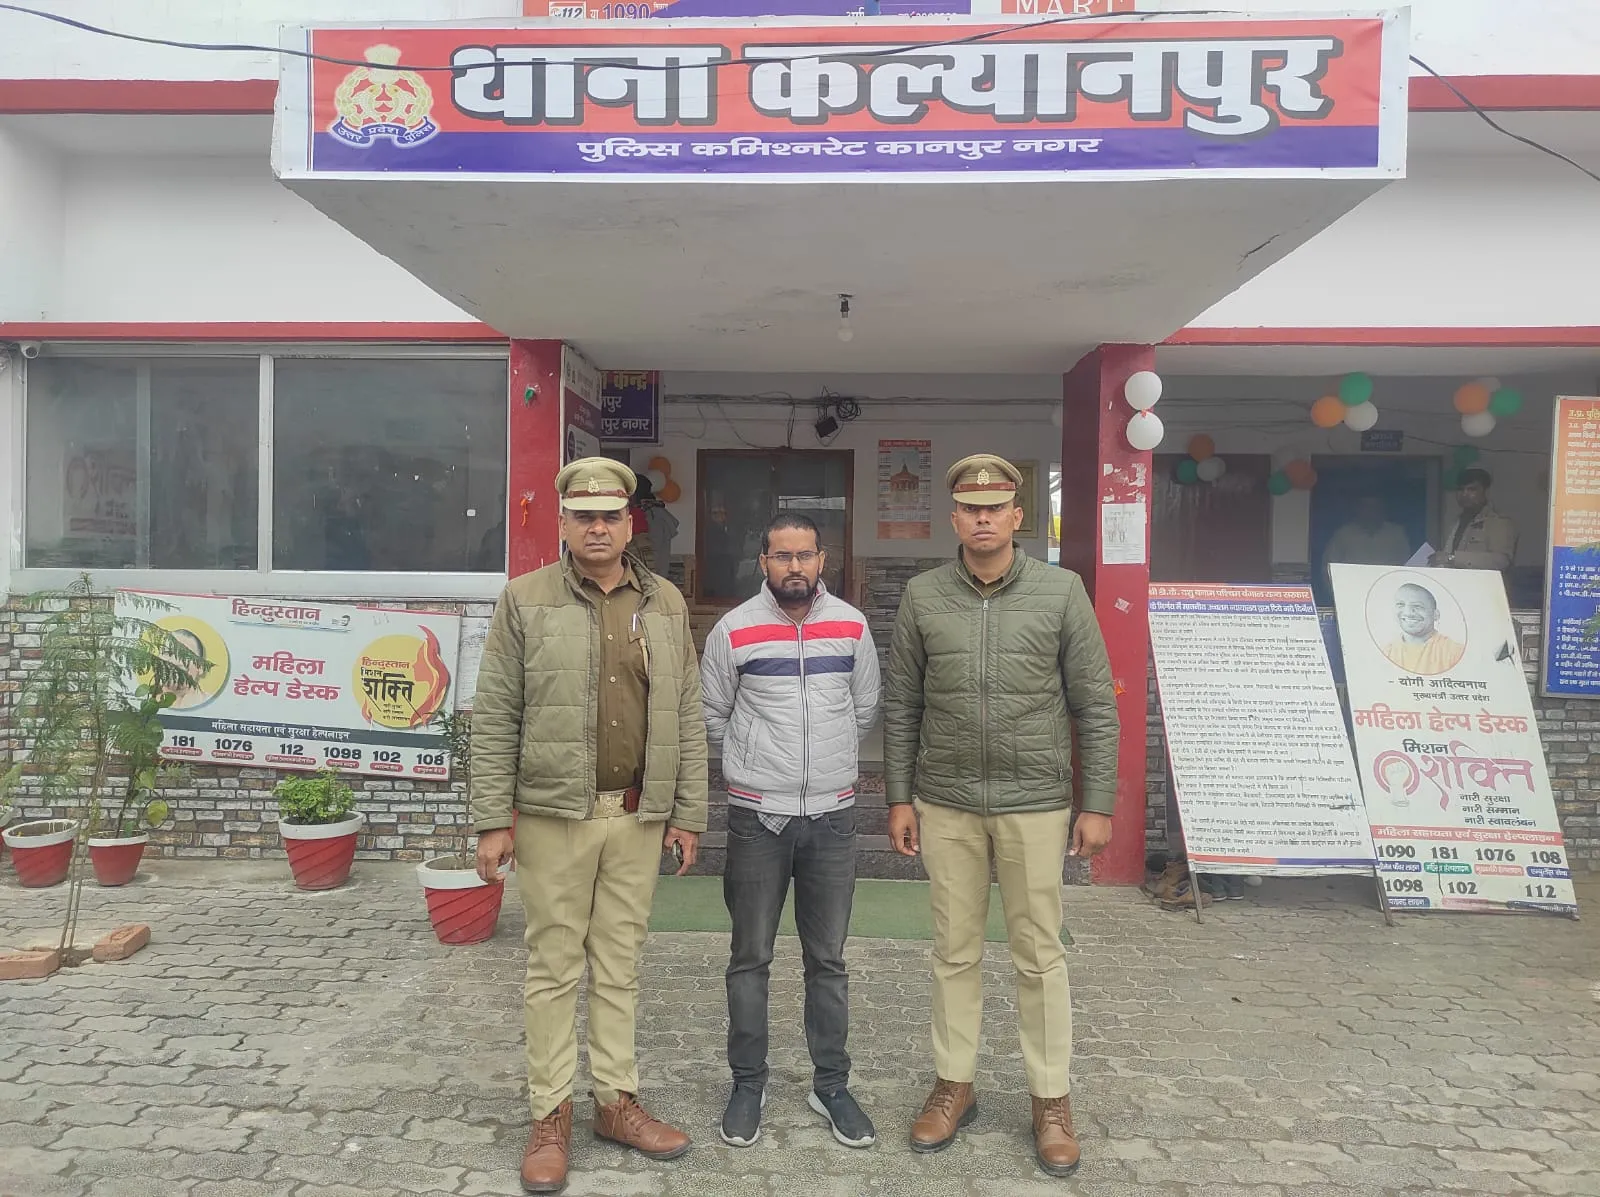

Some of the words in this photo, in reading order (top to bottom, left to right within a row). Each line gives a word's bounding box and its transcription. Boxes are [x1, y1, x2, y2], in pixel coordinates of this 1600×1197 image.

[602, 3, 651, 19] 1090
[1016, 0, 1123, 15] MART
[452, 43, 730, 127] थाना
[740, 36, 1343, 139] कल्यानपुर
[338, 127, 362, 142] उत्तर
[368, 125, 399, 135] प्रदेश
[405, 124, 433, 143] पुलिस
[577, 137, 682, 163] पुलिस
[690, 136, 869, 157] कमिश्नरेट
[875, 140, 1006, 161] कानपुर
[1012, 138, 1103, 154] नगर
[621, 418, 650, 430] नगर
[232, 598, 321, 622] हिन्दुस्तान
[252, 651, 326, 675] महिला
[361, 656, 410, 669] हिन्दुस्तान
[233, 674, 280, 697] हेल्प
[285, 678, 341, 700] डेस्क
[1398, 676, 1424, 687] योगी
[1429, 677, 1488, 690] आदित्यनाथ
[361, 672, 418, 711] शक्ति
[1353, 702, 1422, 730] महिला
[1426, 706, 1472, 732] हेल्प
[1476, 708, 1528, 734] डेस्क
[211, 720, 237, 732] महिला
[239, 723, 271, 735] सहायता
[288, 727, 311, 739] सुरक्षा
[312, 726, 350, 740] हेल्पलाइन
[171, 735, 196, 747] 181
[214, 738, 253, 751] 1076
[1402, 738, 1450, 755] मिशन
[280, 743, 304, 756] 112
[323, 746, 362, 760] 1098
[372, 750, 401, 763] 102
[416, 753, 444, 765] 108
[1419, 740, 1535, 811] शक्ति
[1459, 792, 1480, 801] नारी
[1484, 794, 1510, 805] सुरक्षा
[1462, 804, 1483, 814] नारी
[1486, 806, 1520, 815] सम्मान
[1464, 815, 1485, 825] नारी
[1377, 827, 1410, 837] महिला
[1377, 844, 1416, 858] 1090
[1430, 846, 1458, 859] 181
[1475, 848, 1515, 861] 1076
[1530, 850, 1562, 864] 108
[1385, 879, 1423, 892] 1098
[1447, 881, 1478, 894] 102
[1524, 884, 1556, 898] 112
